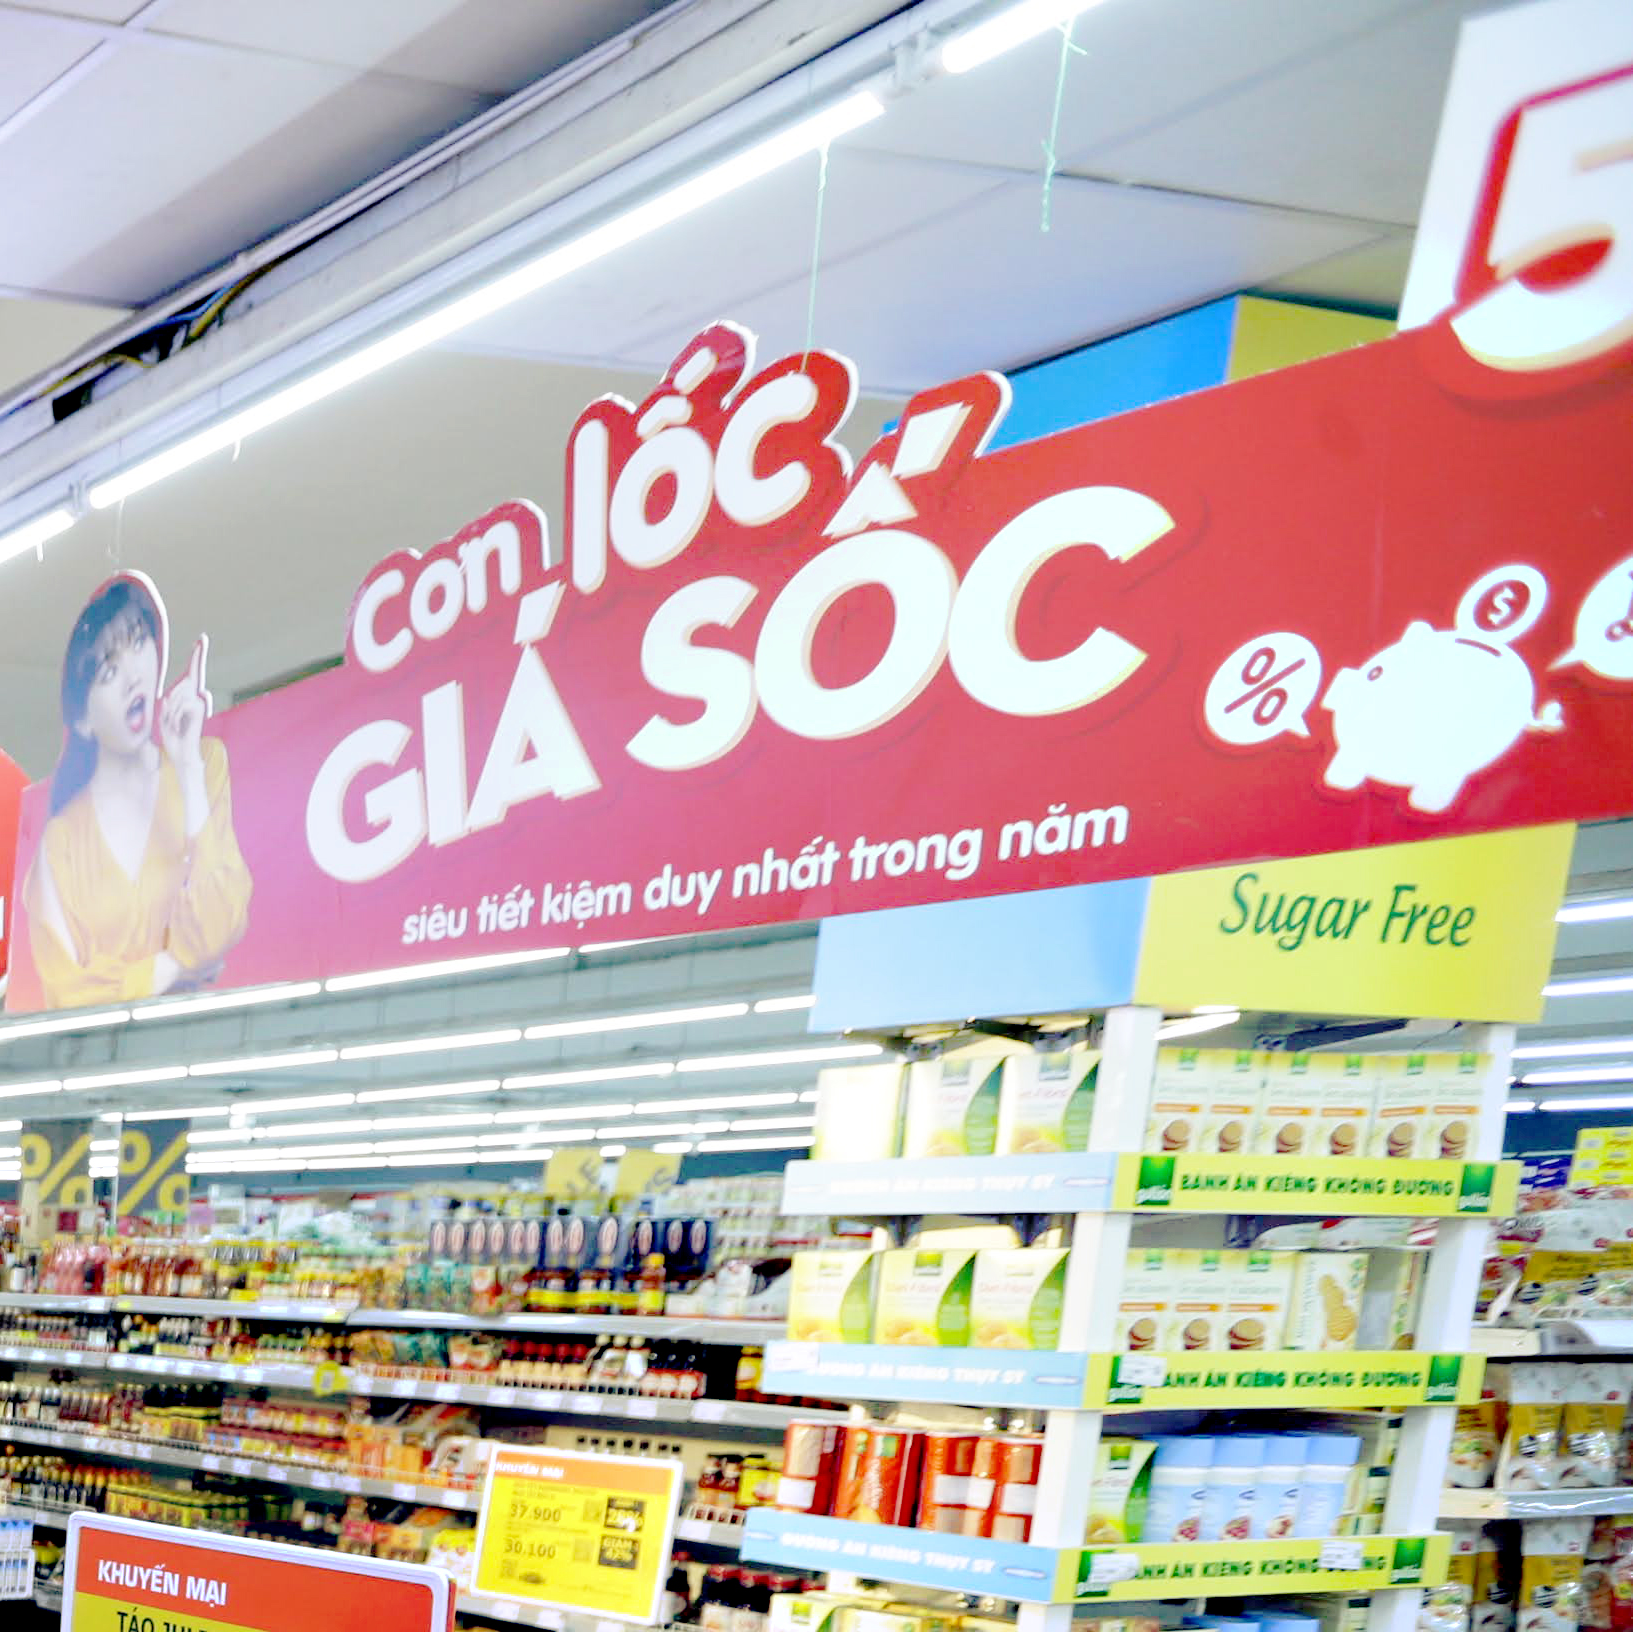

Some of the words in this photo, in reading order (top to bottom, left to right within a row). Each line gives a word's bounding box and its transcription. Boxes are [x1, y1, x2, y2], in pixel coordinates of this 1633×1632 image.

[352, 531, 522, 674] Con
[572, 347, 818, 592] lốc
[305, 580, 602, 883] GIÁ
[625, 402, 1174, 772] SỐC
[401, 897, 468, 945] siêu
[475, 880, 534, 934] tiết
[541, 876, 631, 927] kiệm
[642, 861, 719, 917] duy
[730, 842, 839, 902] nhất
[847, 824, 982, 892] trong
[998, 803, 1130, 861] năm
[1220, 872, 1369, 953] Sugar
[1380, 884, 1477, 948] Free
[504, 1537, 557, 1560] 30.100
[510, 1503, 562, 1523] 37.900
[98, 1558, 180, 1596] KHUYẾN
[186, 1576, 226, 1608] MẠI
